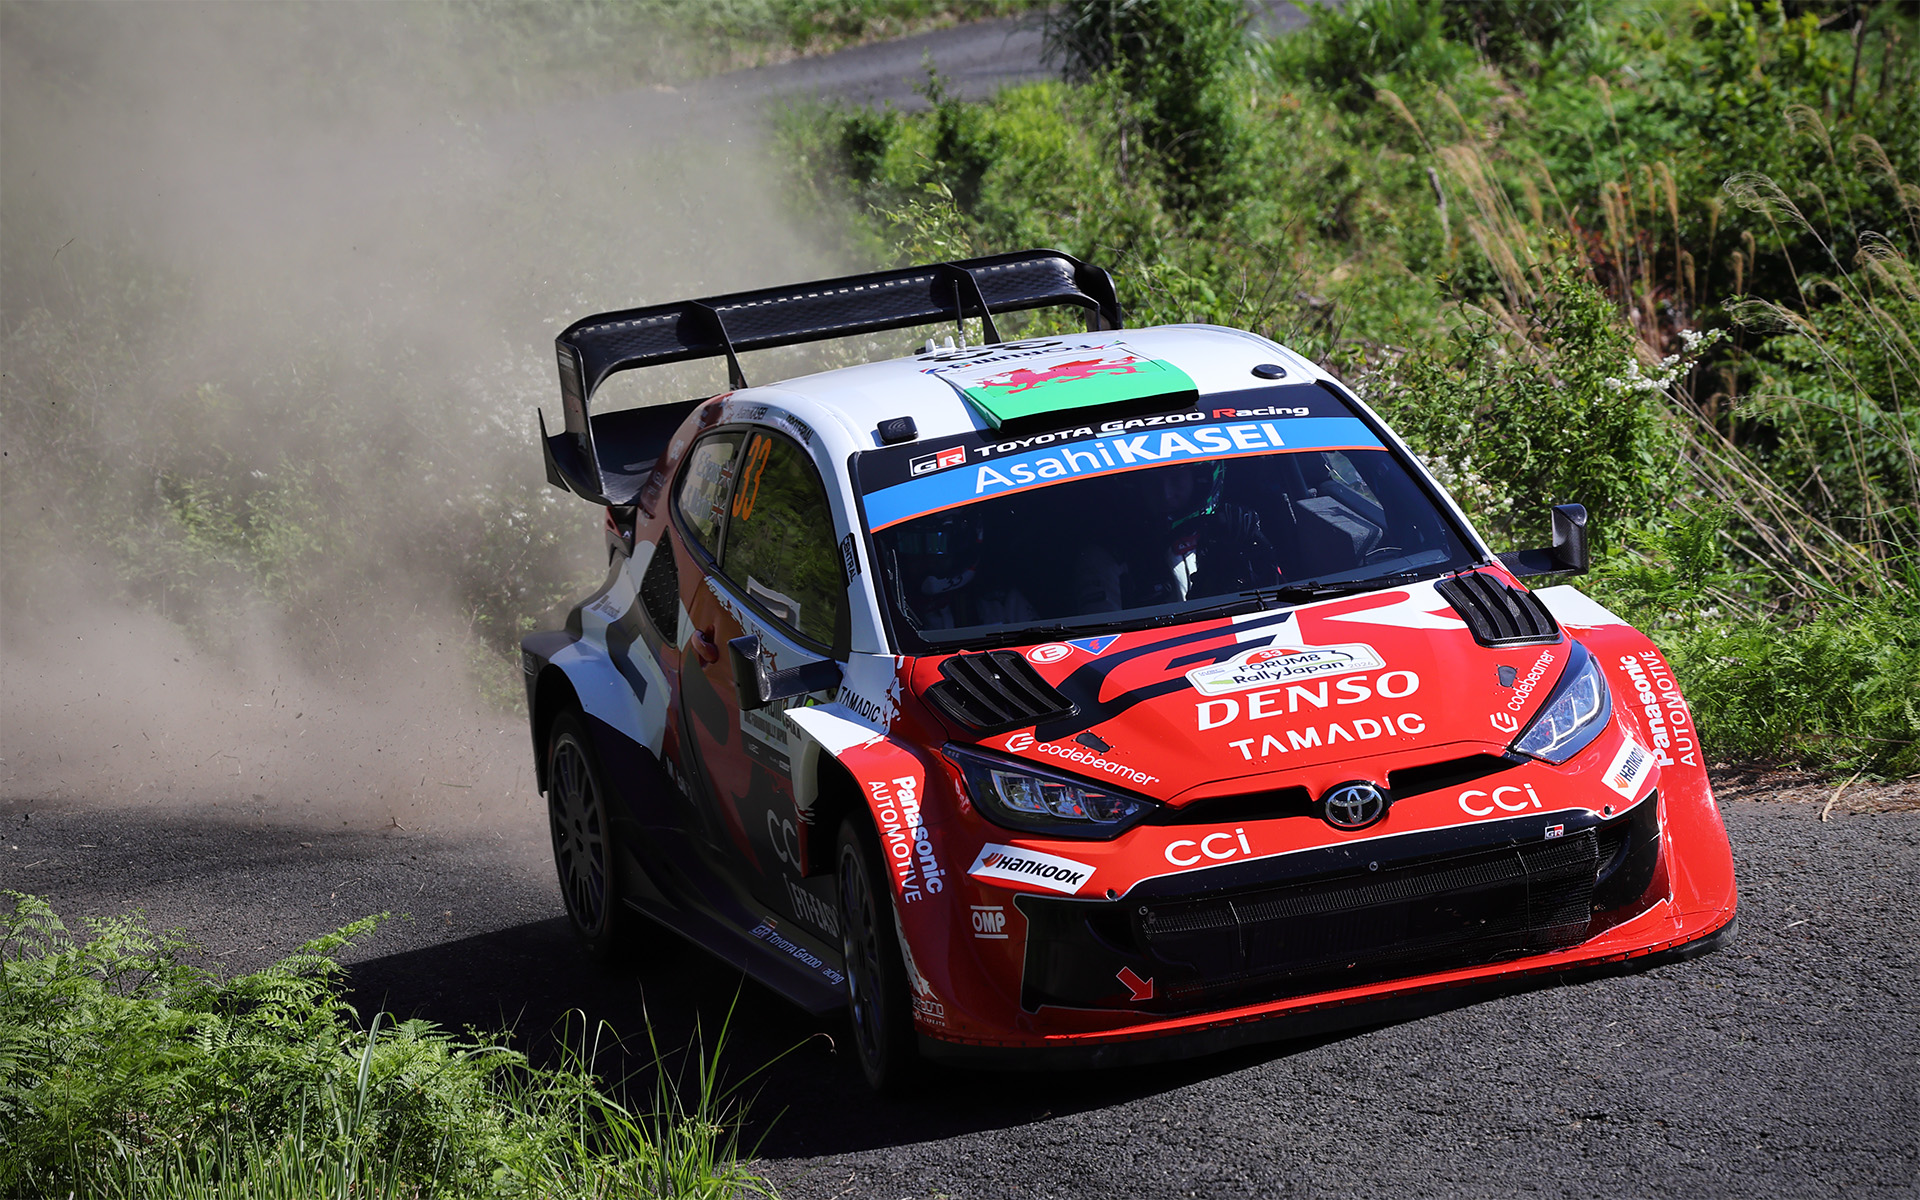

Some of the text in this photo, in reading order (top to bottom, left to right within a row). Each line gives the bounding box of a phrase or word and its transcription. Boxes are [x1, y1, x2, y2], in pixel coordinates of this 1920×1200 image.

[974, 406, 1310, 457] TOYOTA GAZOO Racing
[975, 423, 1286, 494] AsahiKASEI
[732, 434, 772, 520] 33
[913, 453, 964, 475] GR
[1239, 654, 1321, 672] FORUM8
[1259, 649, 1284, 659] 33
[1507, 650, 1556, 712] codebeamer
[839, 686, 881, 722] TAMADIC
[1195, 670, 1420, 731] DENSO
[1620, 655, 1674, 767] Panasonic
[1639, 650, 1697, 767] AUTOMOTIVE
[1037, 742, 1156, 786] codebeamer
[1228, 713, 1426, 760] TAMADIC
[767, 809, 801, 874] CC
[868, 781, 922, 904] AUTOMOTIVE
[892, 775, 946, 894] Panasonic
[766, 931, 797, 957] TOYOTA
[794, 948, 822, 969] GAZOO
[971, 911, 1006, 933] OMP
